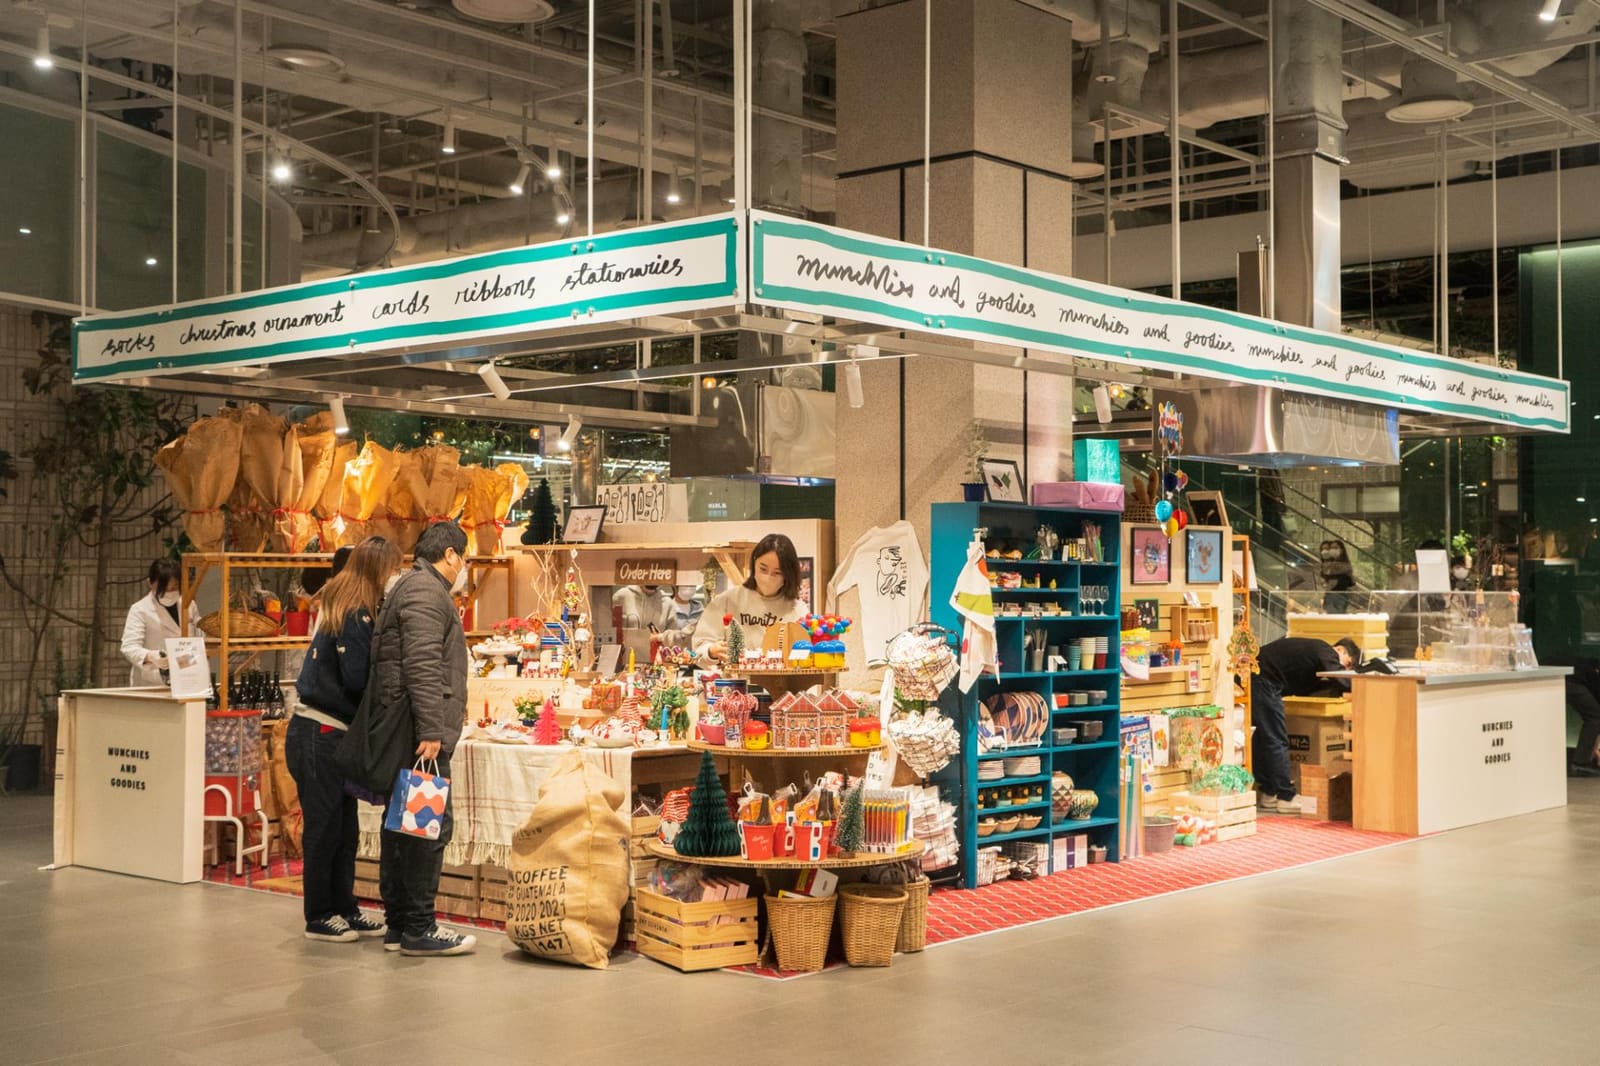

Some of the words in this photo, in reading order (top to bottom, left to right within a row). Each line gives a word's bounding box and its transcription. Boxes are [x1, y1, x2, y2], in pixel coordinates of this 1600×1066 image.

[101, 333, 155, 356] socks
[180, 319, 256, 346] christmas
[263, 300, 346, 333] ornament
[372, 290, 430, 320] cards
[454, 273, 536, 305] ribbons
[929, 275, 965, 309] and
[976, 289, 1037, 318] goodies
[1143, 323, 1171, 343] and
[1183, 330, 1236, 353] goodies
[1311, 353, 1338, 372] and
[1345, 361, 1387, 381] goodies
[1446, 380, 1467, 396] and
[619, 562, 648, 581] Order
[648, 562, 672, 581] Here
[1482, 721, 1513, 732] MUNCHIES
[1491, 737, 1504, 747] AND
[108, 747, 150, 760] MUNCHIES
[1484, 752, 1511, 764] GOODIES
[120, 764, 137, 773] AND
[111, 778, 146, 791] GOODIES
[515, 866, 569, 884] COFFEE
[516, 882, 566, 900] GUATEMALA
[514, 924, 536, 937] KGS
[539, 919, 565, 935] NET
[538, 938, 562, 951] 147
